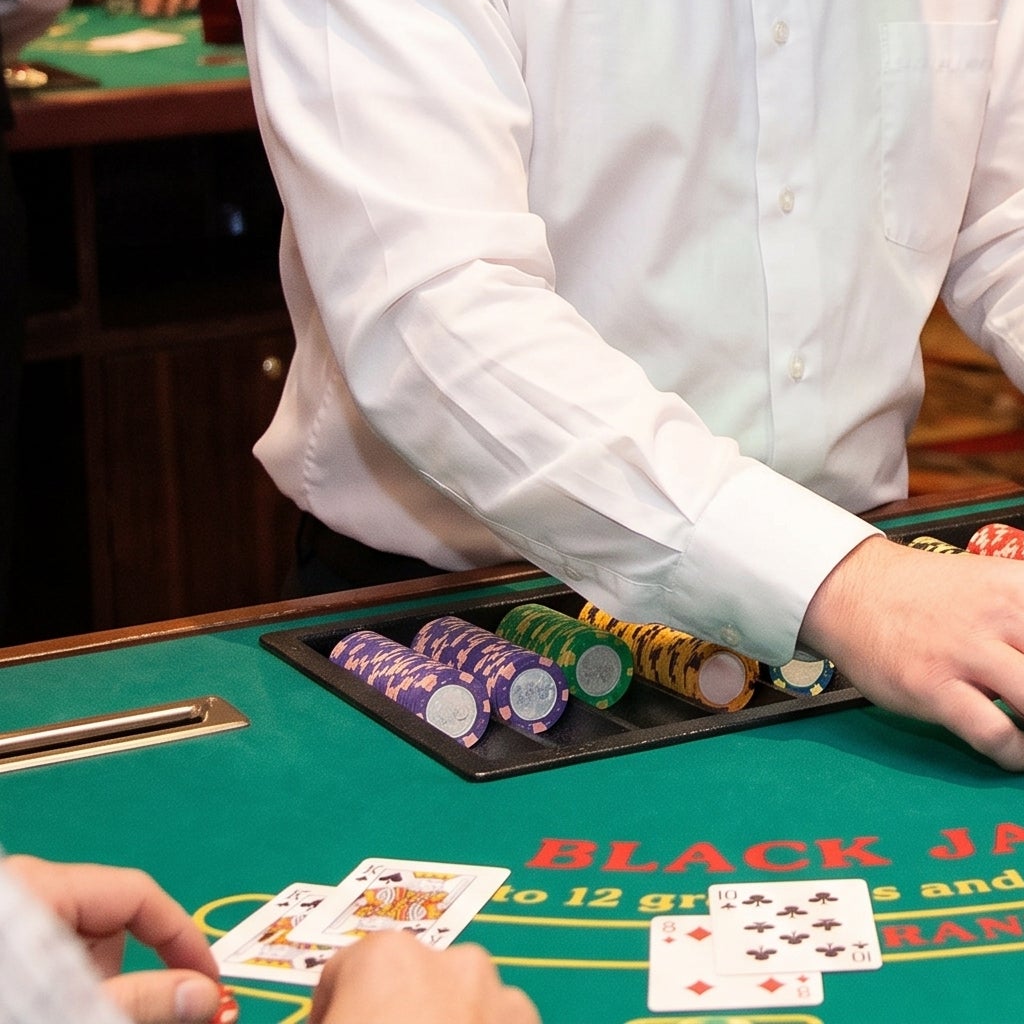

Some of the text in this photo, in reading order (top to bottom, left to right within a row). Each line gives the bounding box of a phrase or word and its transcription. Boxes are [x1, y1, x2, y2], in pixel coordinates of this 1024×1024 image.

[526, 836, 891, 873] BLACK
[564, 887, 622, 907] 12
[638, 892, 710, 912] gr
[718, 889, 738, 901] 10
